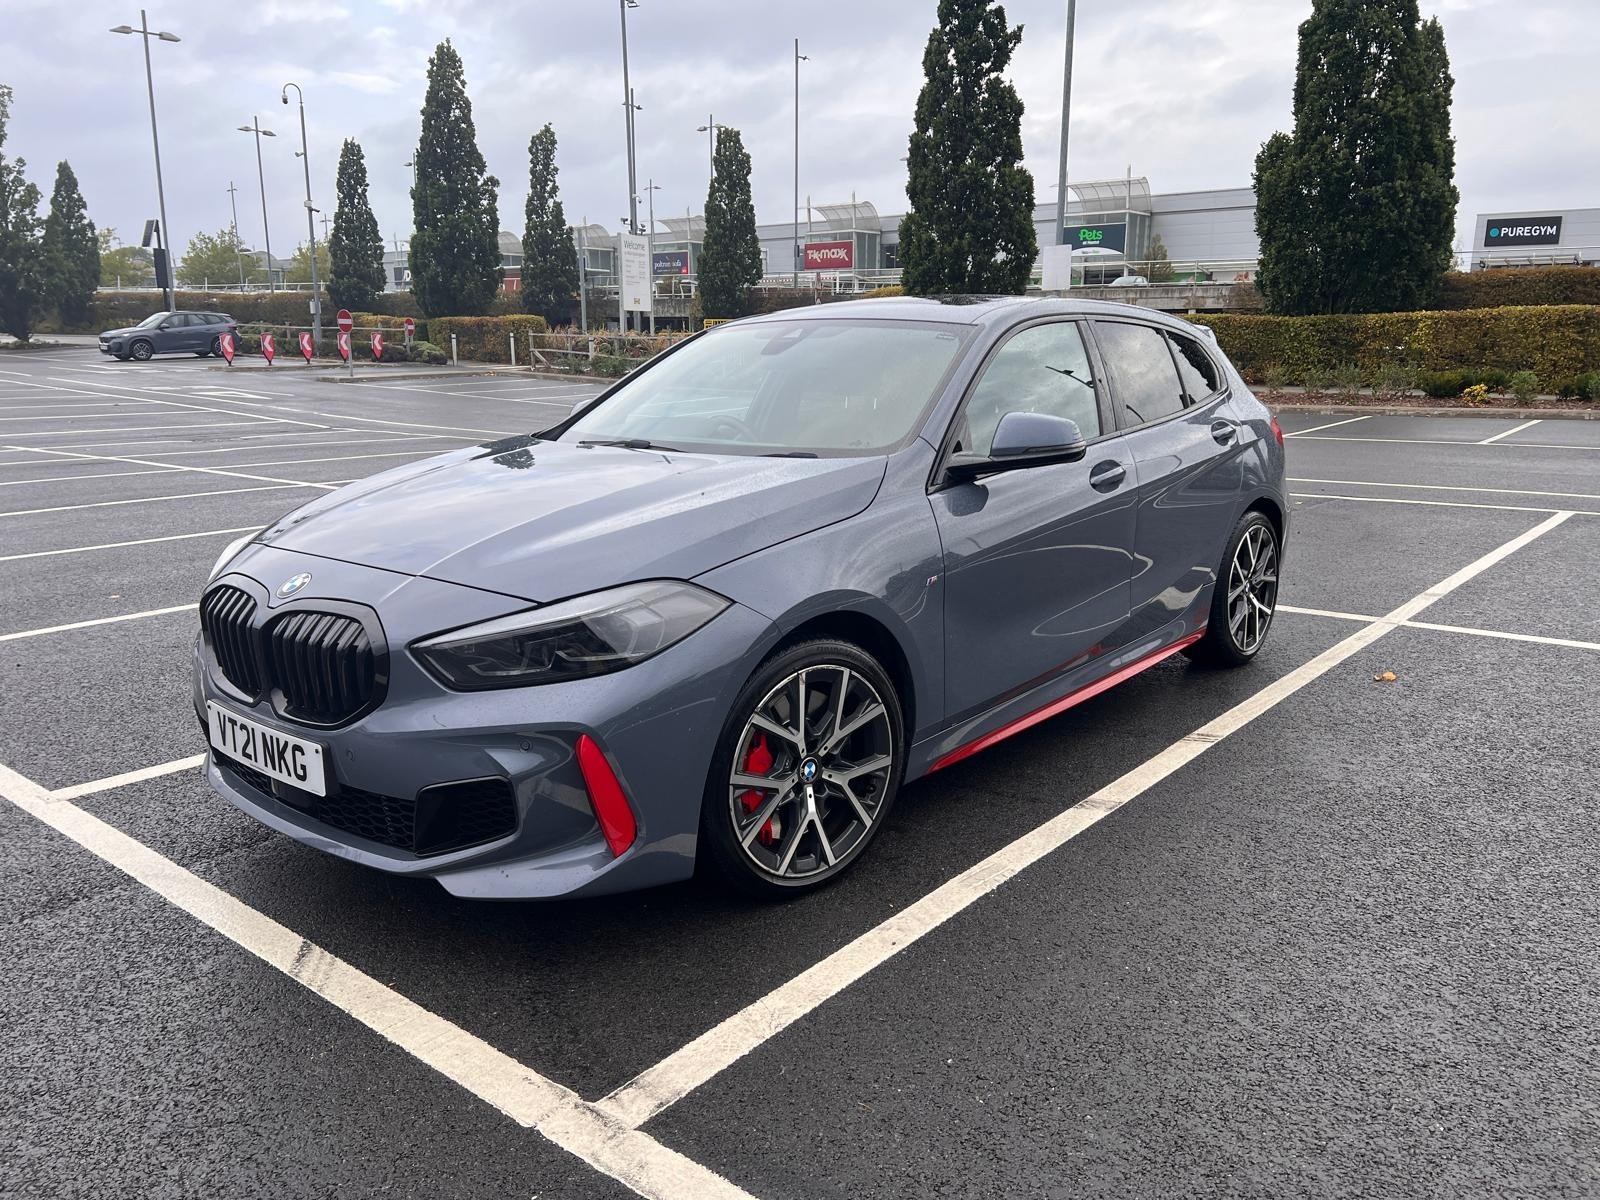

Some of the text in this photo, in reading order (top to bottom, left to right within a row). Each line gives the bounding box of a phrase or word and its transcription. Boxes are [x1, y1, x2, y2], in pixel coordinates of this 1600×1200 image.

[1078, 228, 1103, 241] Pets
[1500, 225, 1557, 236] PUREGYM
[623, 240, 646, 251] Welcome
[216, 710, 308, 782] VT21 NKG
